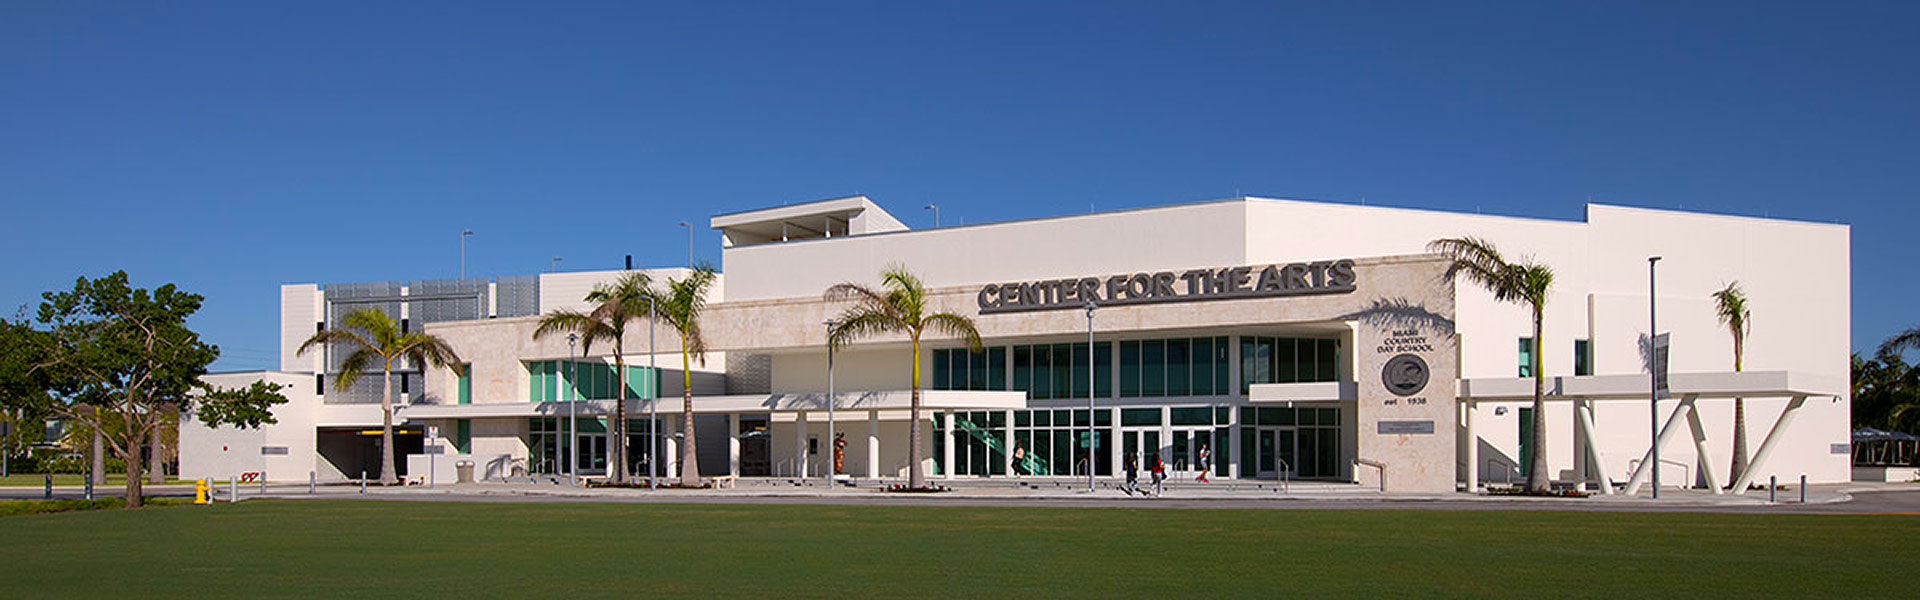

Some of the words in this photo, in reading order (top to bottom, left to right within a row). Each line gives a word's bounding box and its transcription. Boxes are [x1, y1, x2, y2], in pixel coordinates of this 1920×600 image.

[978, 277, 1101, 310] CENTER
[1107, 272, 1177, 302] FOR
[1180, 266, 1252, 296] THE
[1256, 258, 1356, 292] ARTS
[1384, 337, 1427, 345] COUNTRY
[1396, 344, 1434, 352] SCHOOL
